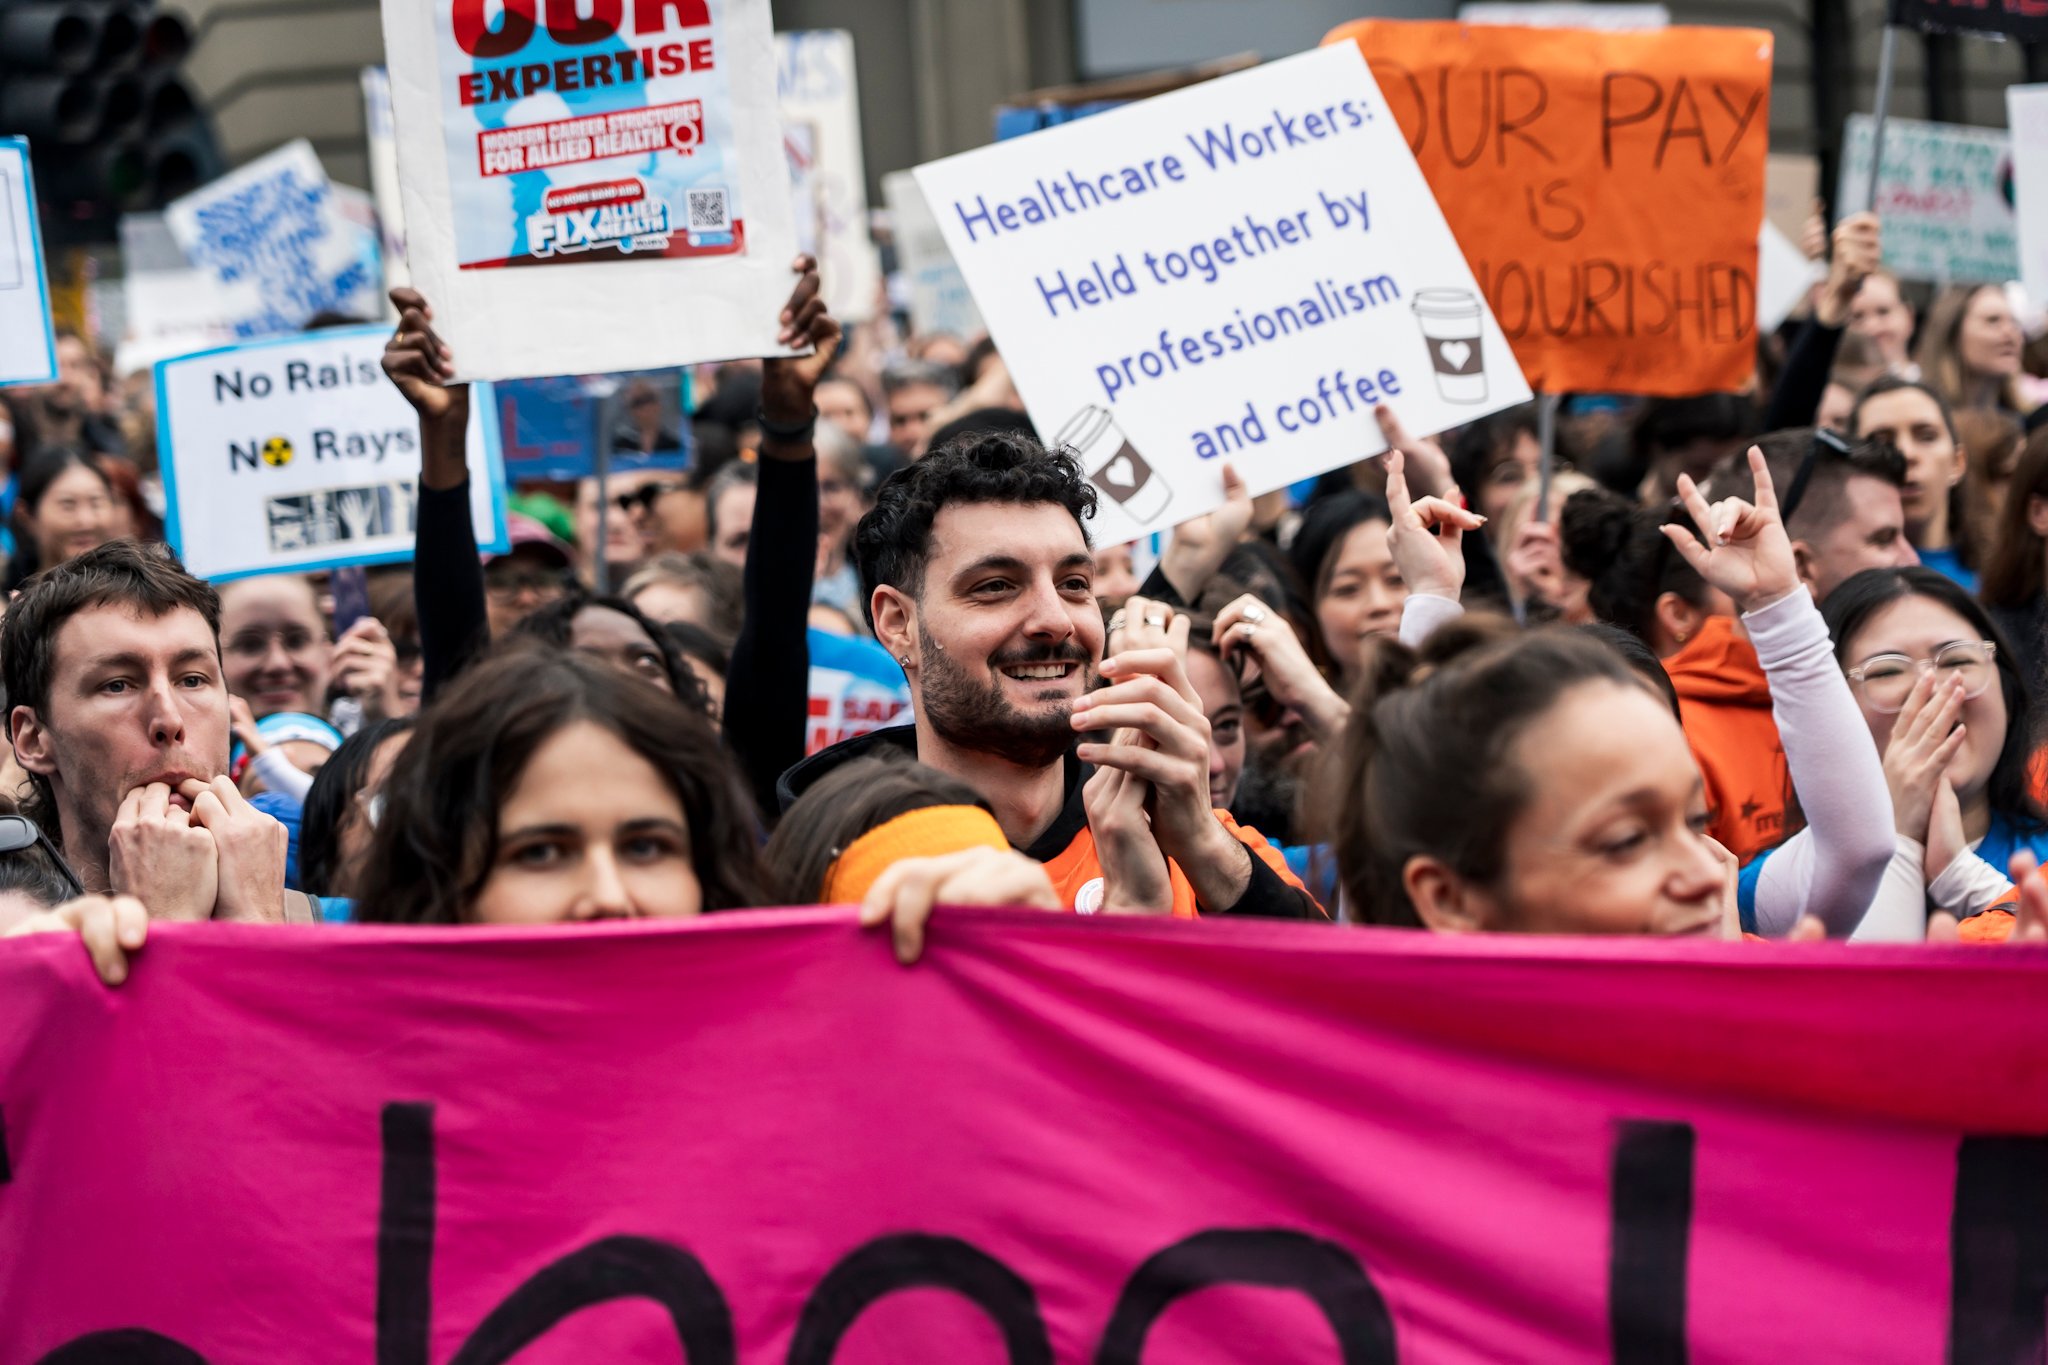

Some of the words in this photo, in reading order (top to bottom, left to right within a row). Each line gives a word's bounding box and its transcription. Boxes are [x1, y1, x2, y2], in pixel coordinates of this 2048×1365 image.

[458, 38, 715, 106] EXPERTISE
[482, 126, 547, 151] MODERN
[549, 117, 606, 139] CAREER
[608, 101, 701, 131] STRUCTURES
[484, 146, 525, 175] FOR
[526, 135, 592, 168] ALLIED
[593, 125, 667, 158] HEALTH
[1602, 71, 1765, 171] PAY
[955, 155, 1186, 242] Healthcare
[1186, 100, 1373, 170] Workers:
[532, 208, 602, 251] FIX
[599, 199, 663, 221] ALLIED
[599, 215, 666, 239] HEALTH
[1525, 177, 1585, 242] IS
[1035, 254, 1137, 317] Held
[1143, 211, 1311, 283] together
[1318, 190, 1370, 232] by
[1096, 274, 1401, 402] professionalism
[213, 370, 273, 402] No
[286, 355, 384, 392] Rais
[313, 427, 416, 463] Rays
[1191, 402, 1268, 460] and
[1276, 369, 1402, 433] coffee
